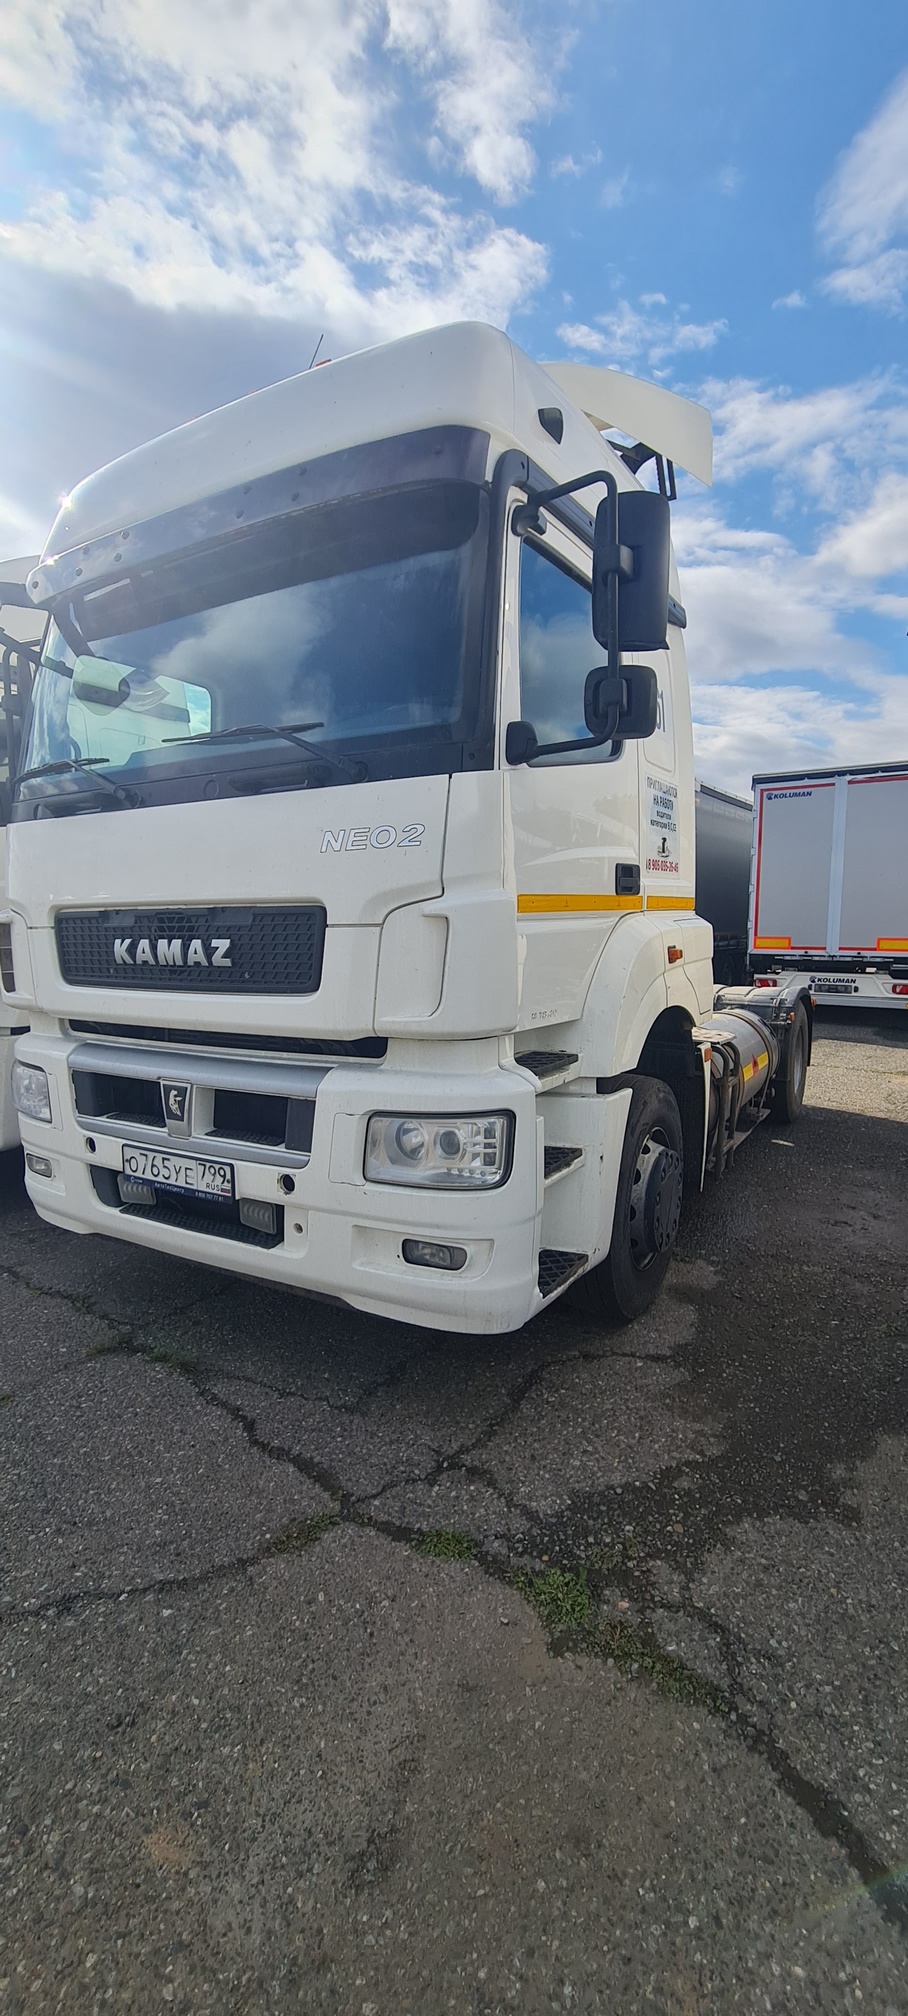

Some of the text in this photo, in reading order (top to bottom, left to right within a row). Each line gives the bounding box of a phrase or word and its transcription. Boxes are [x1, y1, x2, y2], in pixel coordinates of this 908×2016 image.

[653, 793, 660, 807] НА
[773, 790, 812, 800] KOLUMAN
[113, 937, 233, 967] KAMAZ
[816, 976, 857, 985] KOLUMAN
[198, 1162, 228, 1185] 799
[205, 1181, 221, 1192] RUS
